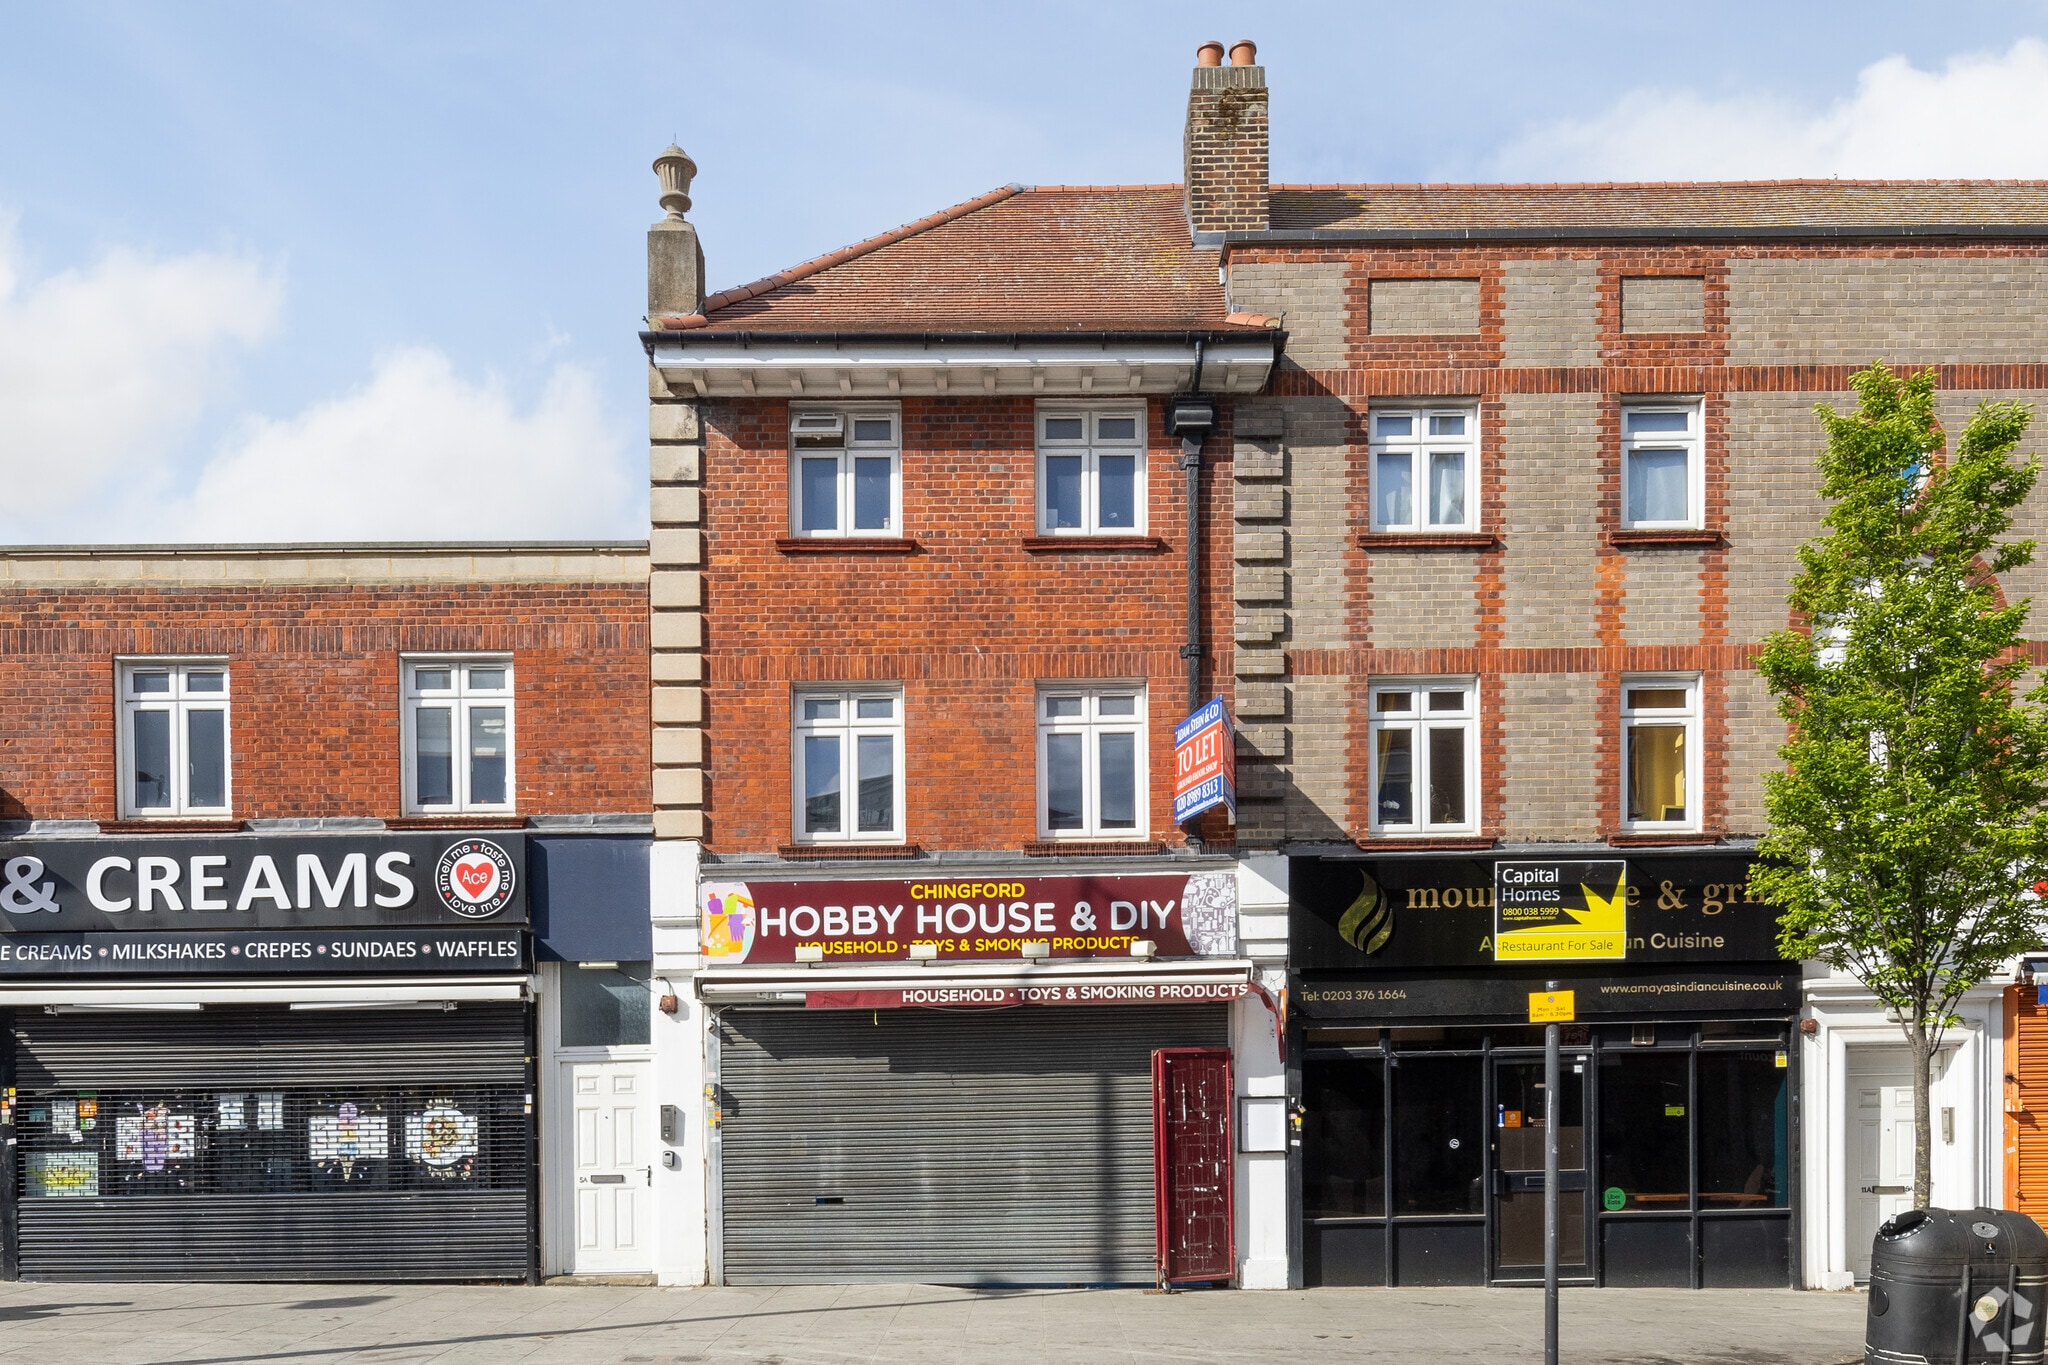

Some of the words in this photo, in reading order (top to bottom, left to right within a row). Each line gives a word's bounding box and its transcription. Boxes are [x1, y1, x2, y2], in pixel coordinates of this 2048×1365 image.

[1205, 709, 1210, 723] &
[1178, 746, 1192, 776] TO
[1195, 729, 1217, 766] LET
[1202, 779, 1218, 798] 8313
[440, 858, 453, 891] smell
[450, 845, 470, 860] me
[480, 843, 506, 867] taste
[501, 870, 510, 890] me
[0, 856, 60, 913] &
[86, 852, 415, 912] CREAMS
[462, 869, 488, 885] Ace
[1502, 868, 1559, 886] Capital
[911, 882, 1025, 900] CHINGFORD
[1502, 888, 1560, 902] Homes
[1657, 880, 1688, 911] &
[449, 895, 476, 913] love
[480, 898, 500, 912] me
[1503, 908, 1522, 916] 0800
[1524, 907, 1538, 916] 038
[1540, 907, 1559, 916] 5999
[760, 905, 903, 937] HOBBY
[917, 902, 1056, 934] HOUSE
[1070, 901, 1097, 932] &
[1111, 900, 1175, 931] DIY
[959, 938, 970, 951] &
[1502, 941, 1564, 952] Restaurant
[1568, 941, 1586, 951] For
[1590, 940, 1613, 951] Sale
[1650, 932, 1725, 949] Cuisine
[16, 944, 92, 960] CREAMS
[112, 943, 226, 960] MILKSHAKES
[245, 942, 312, 958] CREPES
[331, 941, 416, 958] SUNDAES
[436, 940, 517, 957] WAFFLES
[902, 987, 1004, 1004] HOUSEHOLD
[1018, 986, 1061, 1001] TOYS
[1066, 987, 1077, 1000] &
[1081, 985, 1155, 999] SMOKING
[1160, 984, 1248, 998] PRODUCTS
[1300, 991, 1320, 1001] Tel:
[1322, 990, 1352, 1001] 0203
[1355, 990, 1375, 1000] 376
[1377, 989, 1407, 1000] 1664
[1600, 980, 1783, 995] www.amayasindiancuisine.co.uk
